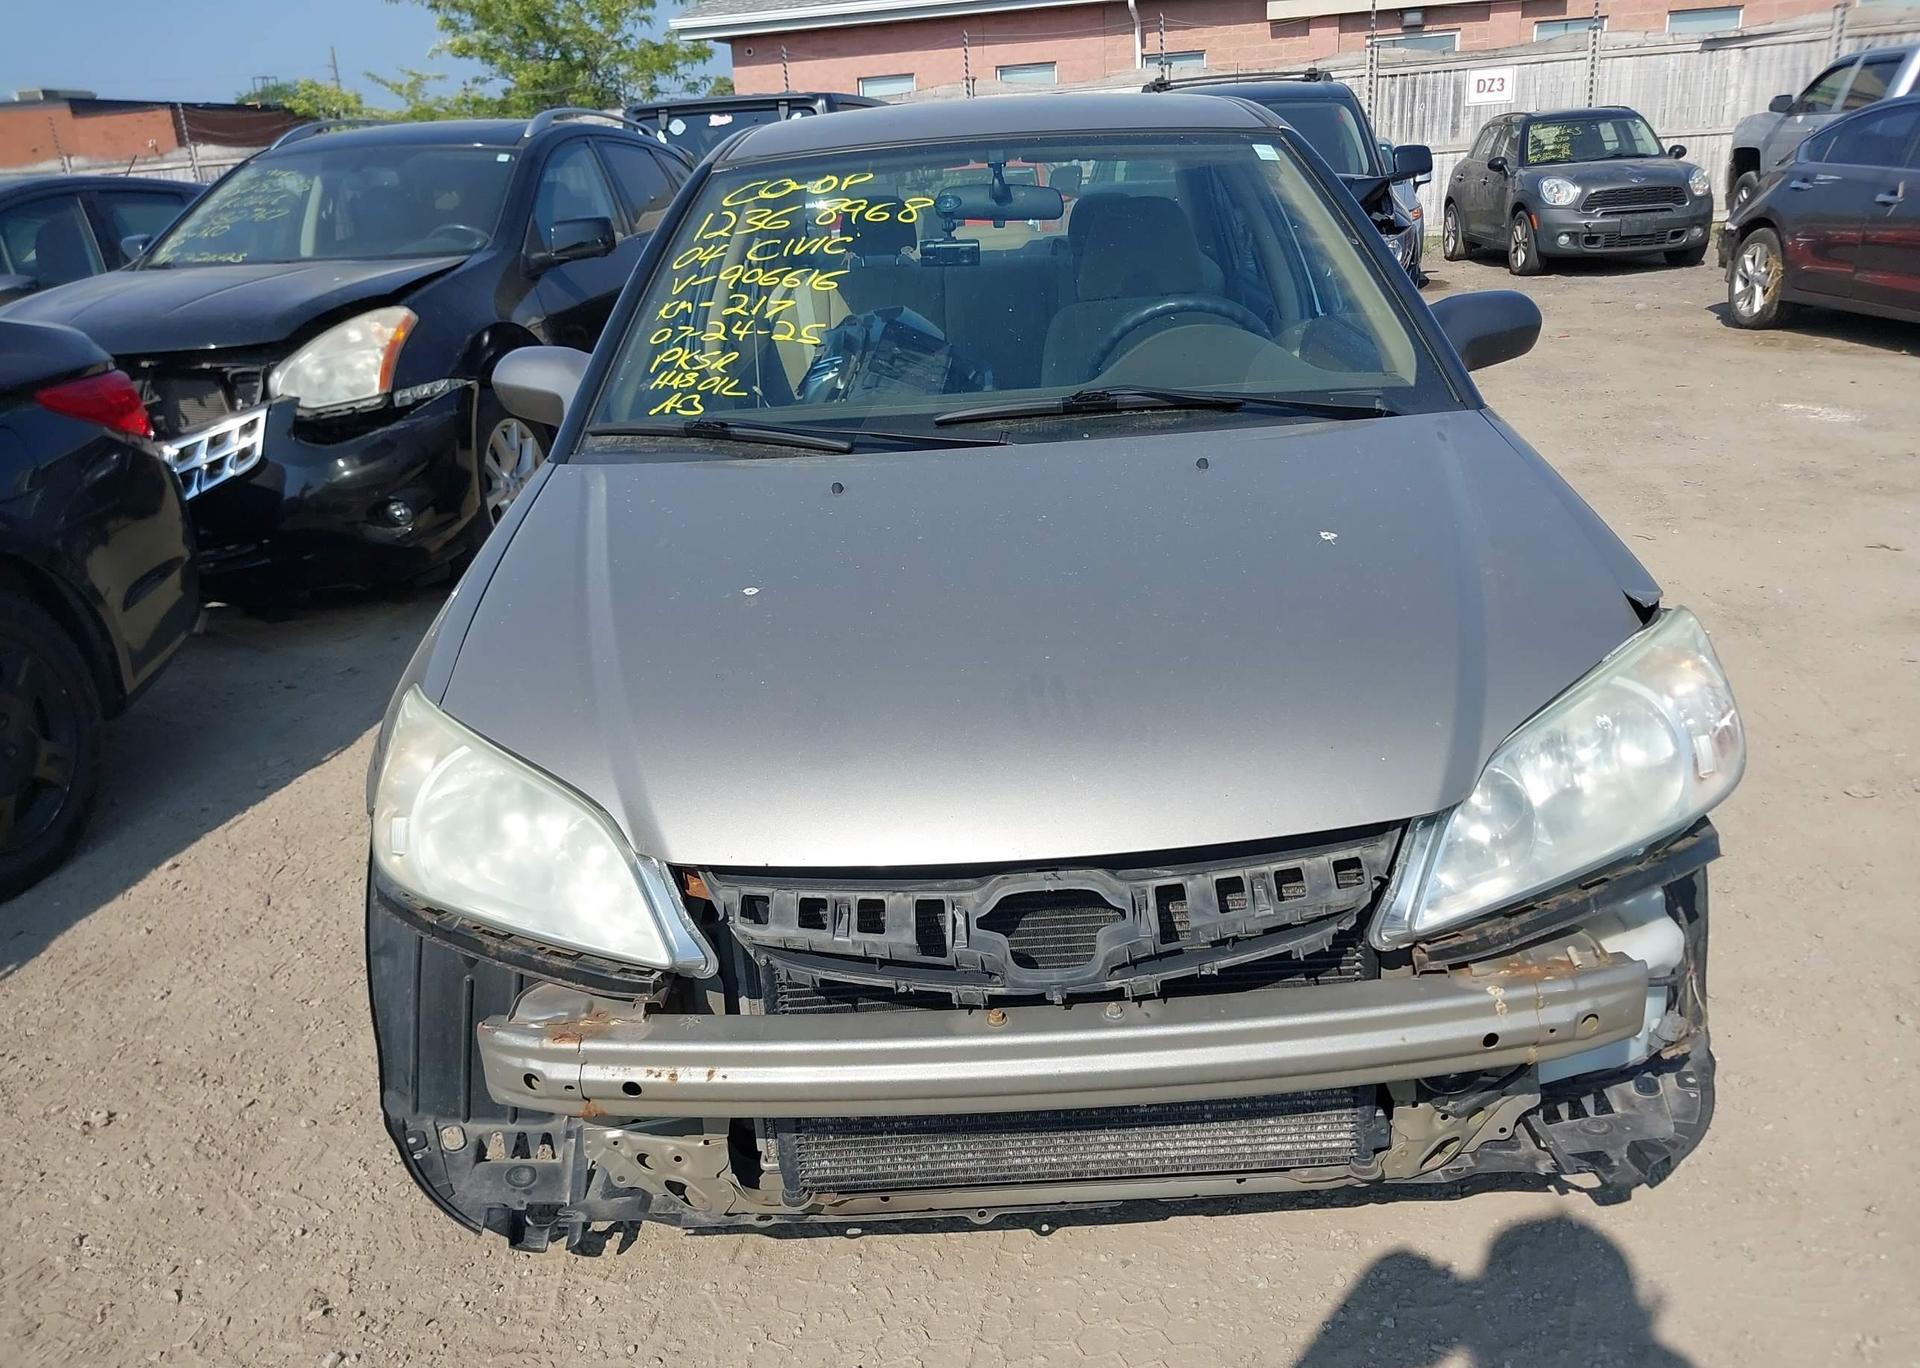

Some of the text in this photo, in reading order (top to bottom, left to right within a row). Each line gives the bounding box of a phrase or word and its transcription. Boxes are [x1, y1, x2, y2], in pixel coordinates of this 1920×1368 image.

[1476, 78, 1505, 93] DZ3
[721, 172, 874, 206] CO-OP
[692, 197, 935, 242] 1236 8968
[672, 237, 854, 270] 04 CIVIC
[671, 264, 850, 295] V-906616
[649, 320, 827, 345] 07-24-25
